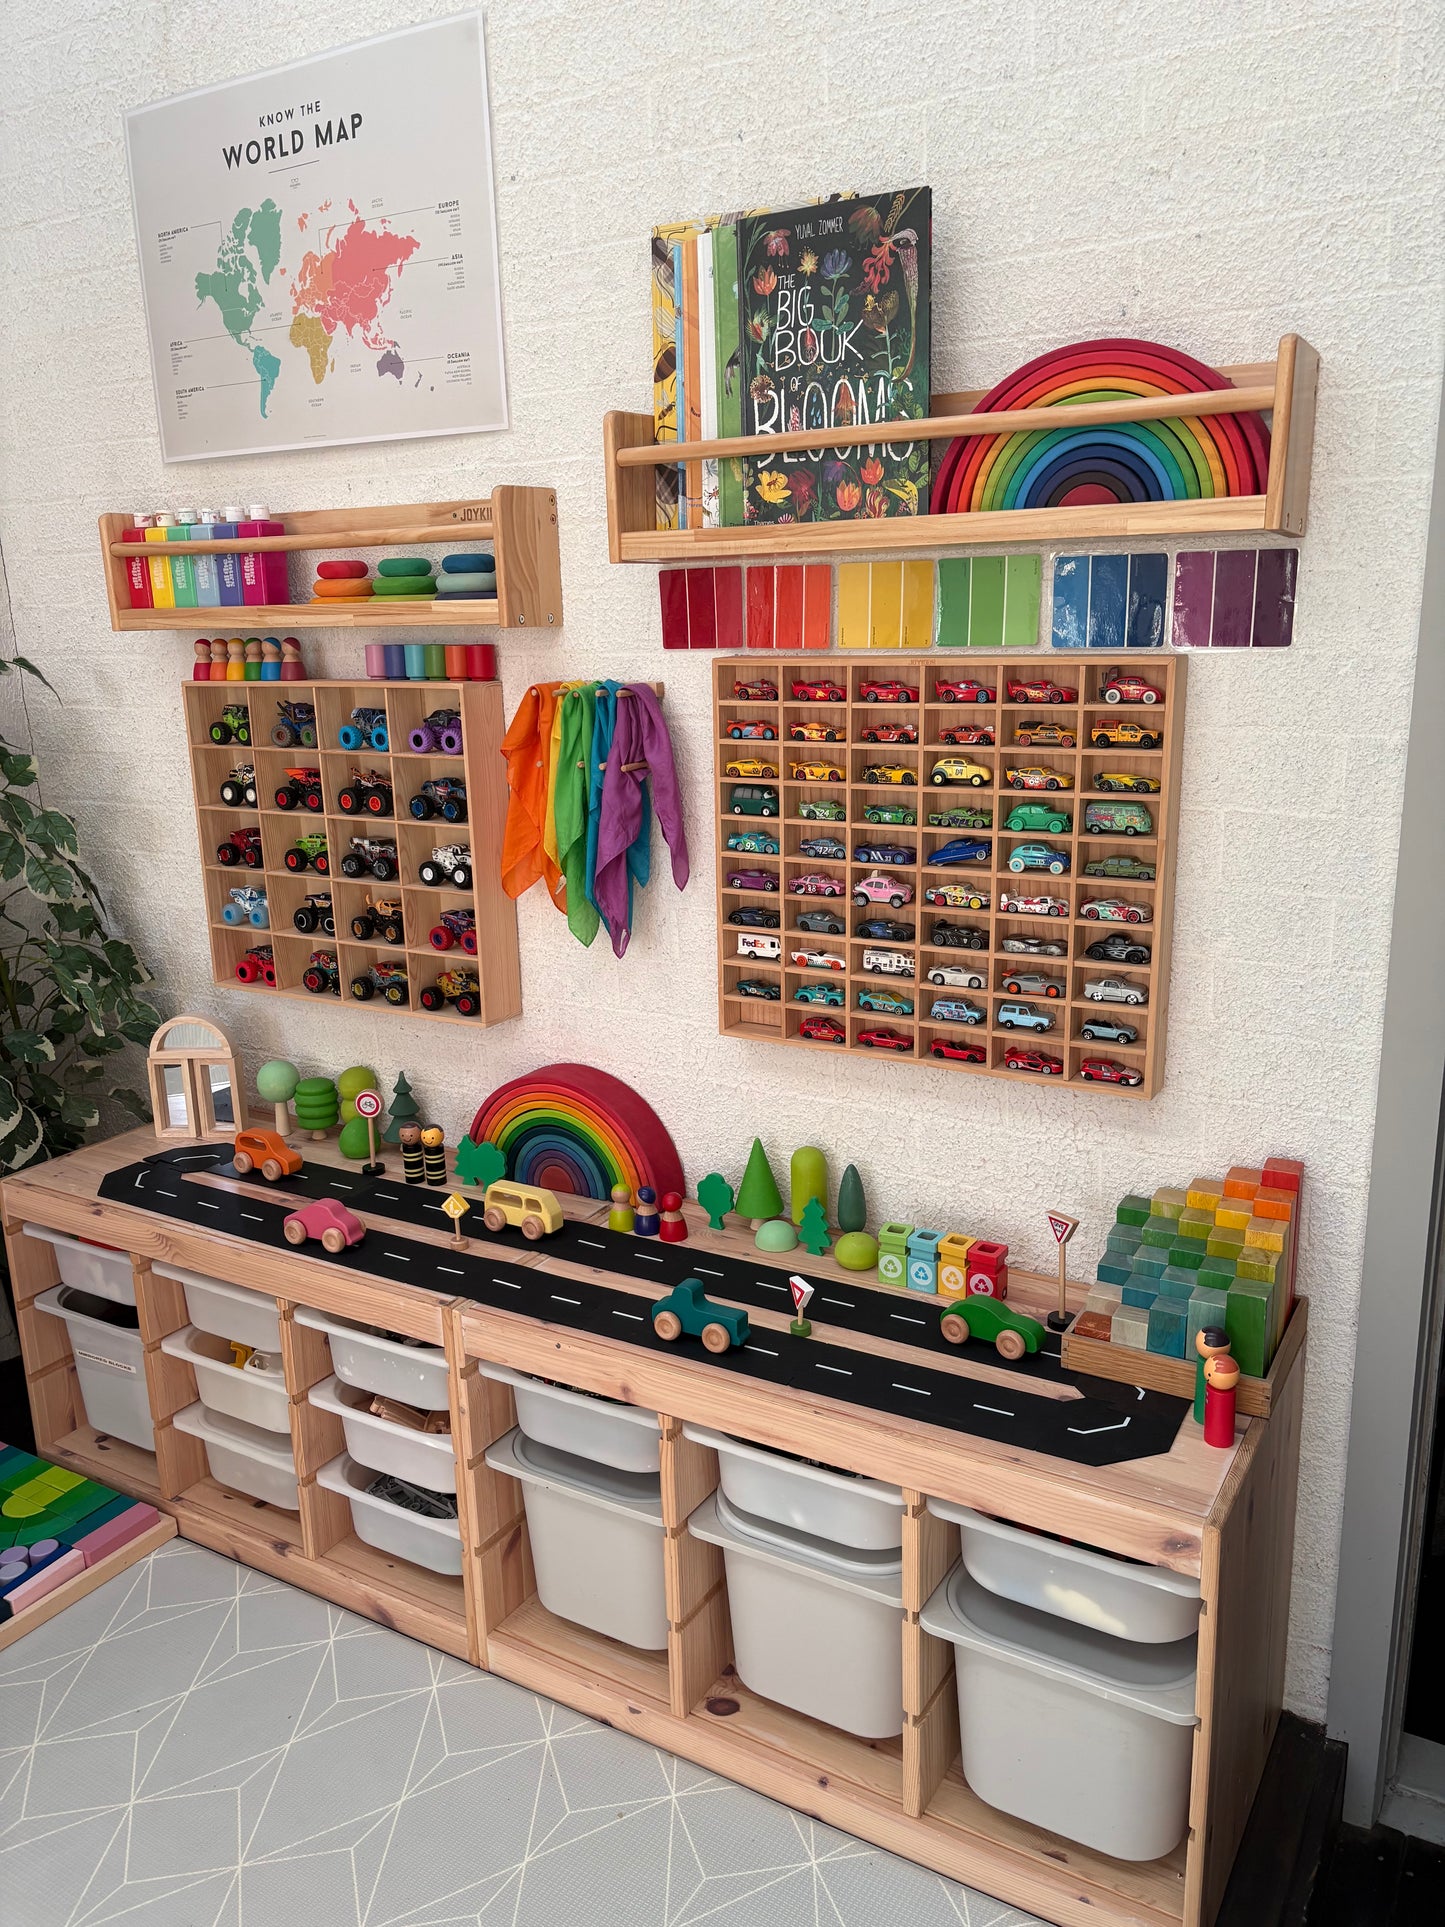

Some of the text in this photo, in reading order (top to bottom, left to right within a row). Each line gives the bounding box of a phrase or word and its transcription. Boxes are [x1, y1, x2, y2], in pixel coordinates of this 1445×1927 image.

[259, 100, 321, 128] KNOW THE
[222, 113, 363, 171] WORLD MAP
[438, 199, 459, 209] EUROPE
[171, 227, 189, 235] AMERICA
[795, 216, 844, 241] YUVAL ZOMMER
[778, 273, 796, 290] THE
[776, 285, 815, 331] BIG
[775, 319, 864, 372] BOOK
[447, 351, 471, 360] OCEANIA
[790, 375, 803, 392] OF
[754, 376, 914, 469] BLOOMS
[460, 507, 493, 522] JOYKI
[820, 809, 830, 817] 24
[818, 847, 829, 855] 42
[952, 895, 964, 903] 27
[742, 938, 766, 949] FedEx
